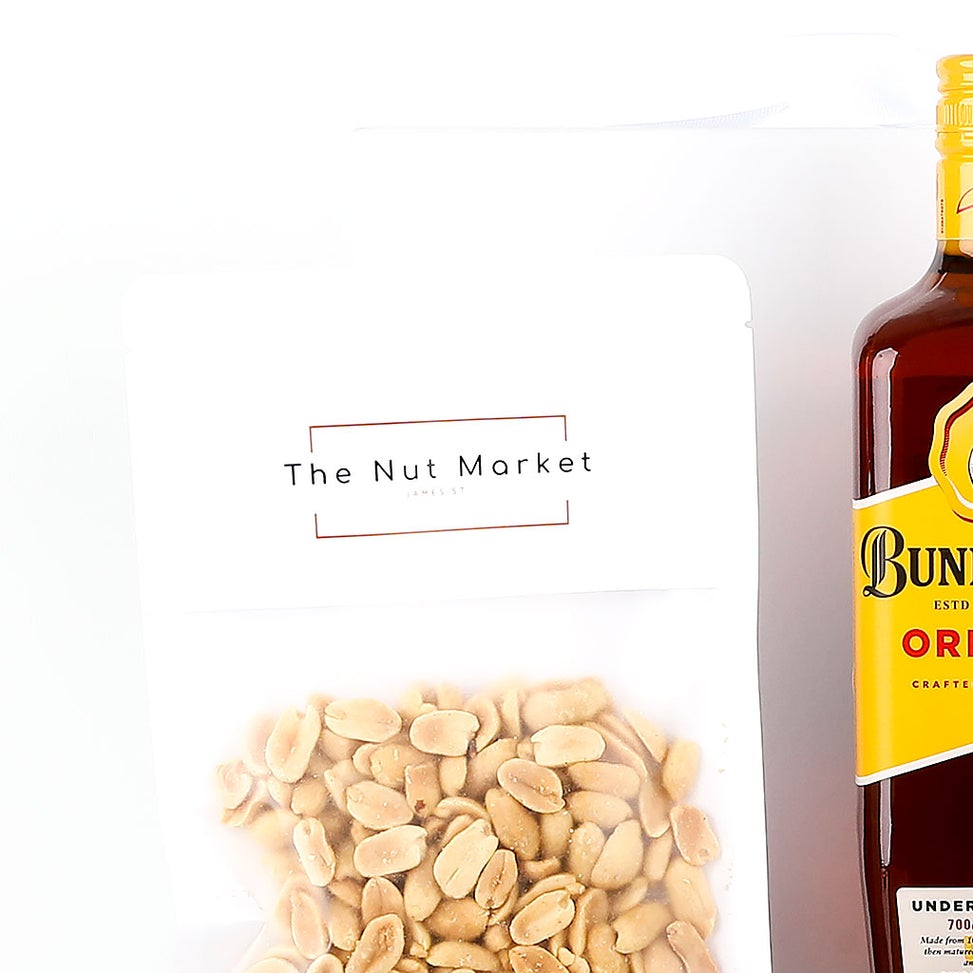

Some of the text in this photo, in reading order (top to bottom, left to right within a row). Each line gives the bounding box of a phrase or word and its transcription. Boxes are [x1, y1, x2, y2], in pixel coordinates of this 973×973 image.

[283, 451, 593, 486] The Nut Market
[933, 599, 970, 611] ESTD
[920, 936, 943, 944] Made
[945, 936, 965, 945] from
[924, 947, 941, 955] then
